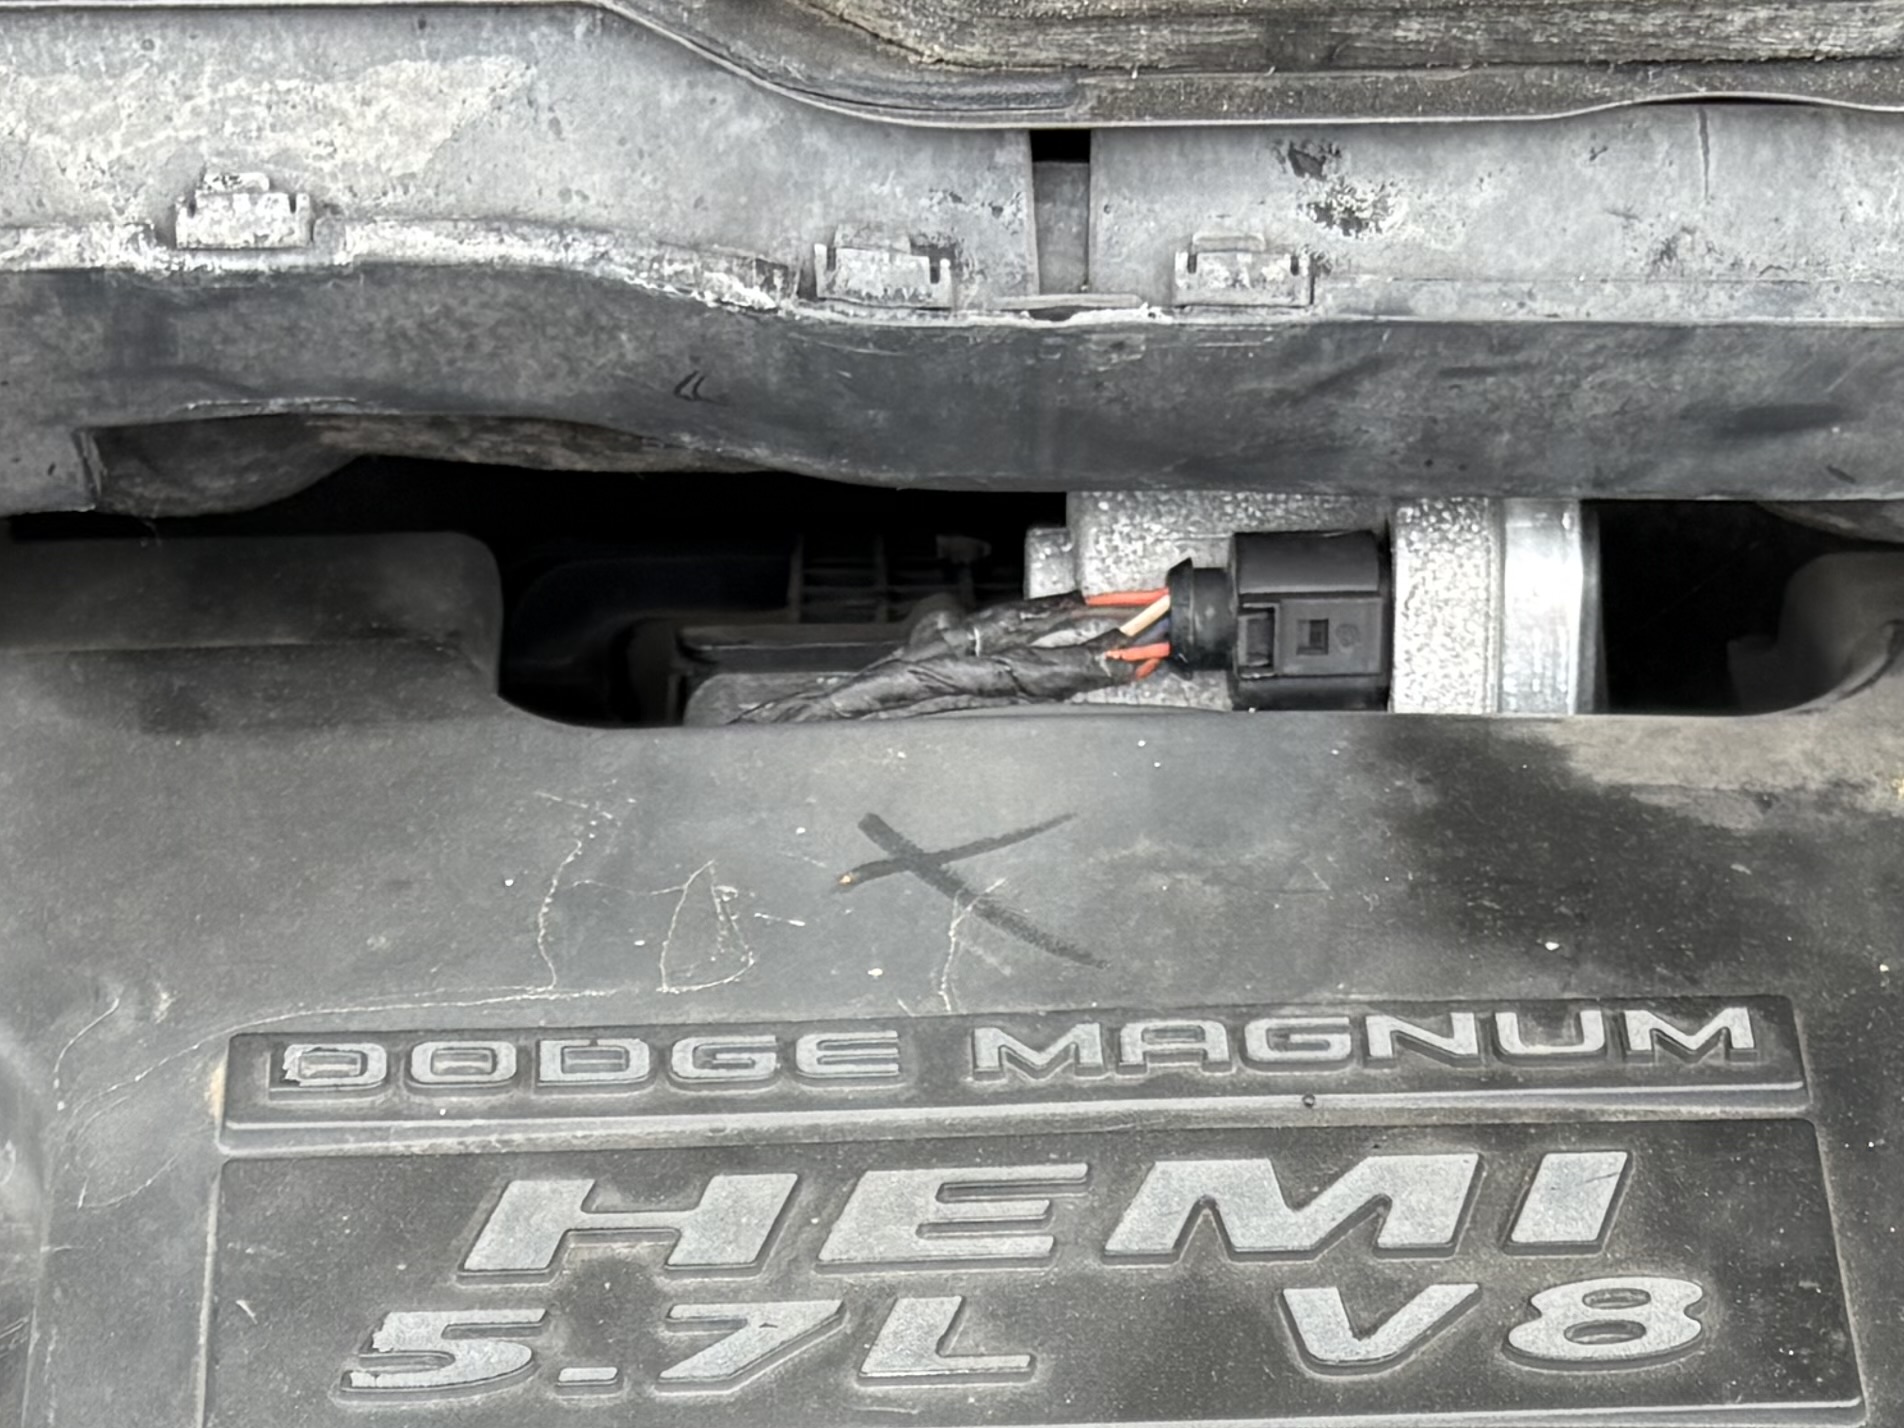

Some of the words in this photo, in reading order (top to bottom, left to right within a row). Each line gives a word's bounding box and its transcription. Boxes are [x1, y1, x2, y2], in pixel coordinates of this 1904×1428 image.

[272, 1028, 900, 1094] DODGE
[972, 1005, 1756, 1078] MAGNUM
[459, 1150, 1630, 1276] HEMI
[332, 1294, 1039, 1396] 5.7L
[1279, 1274, 1704, 1370] V8
